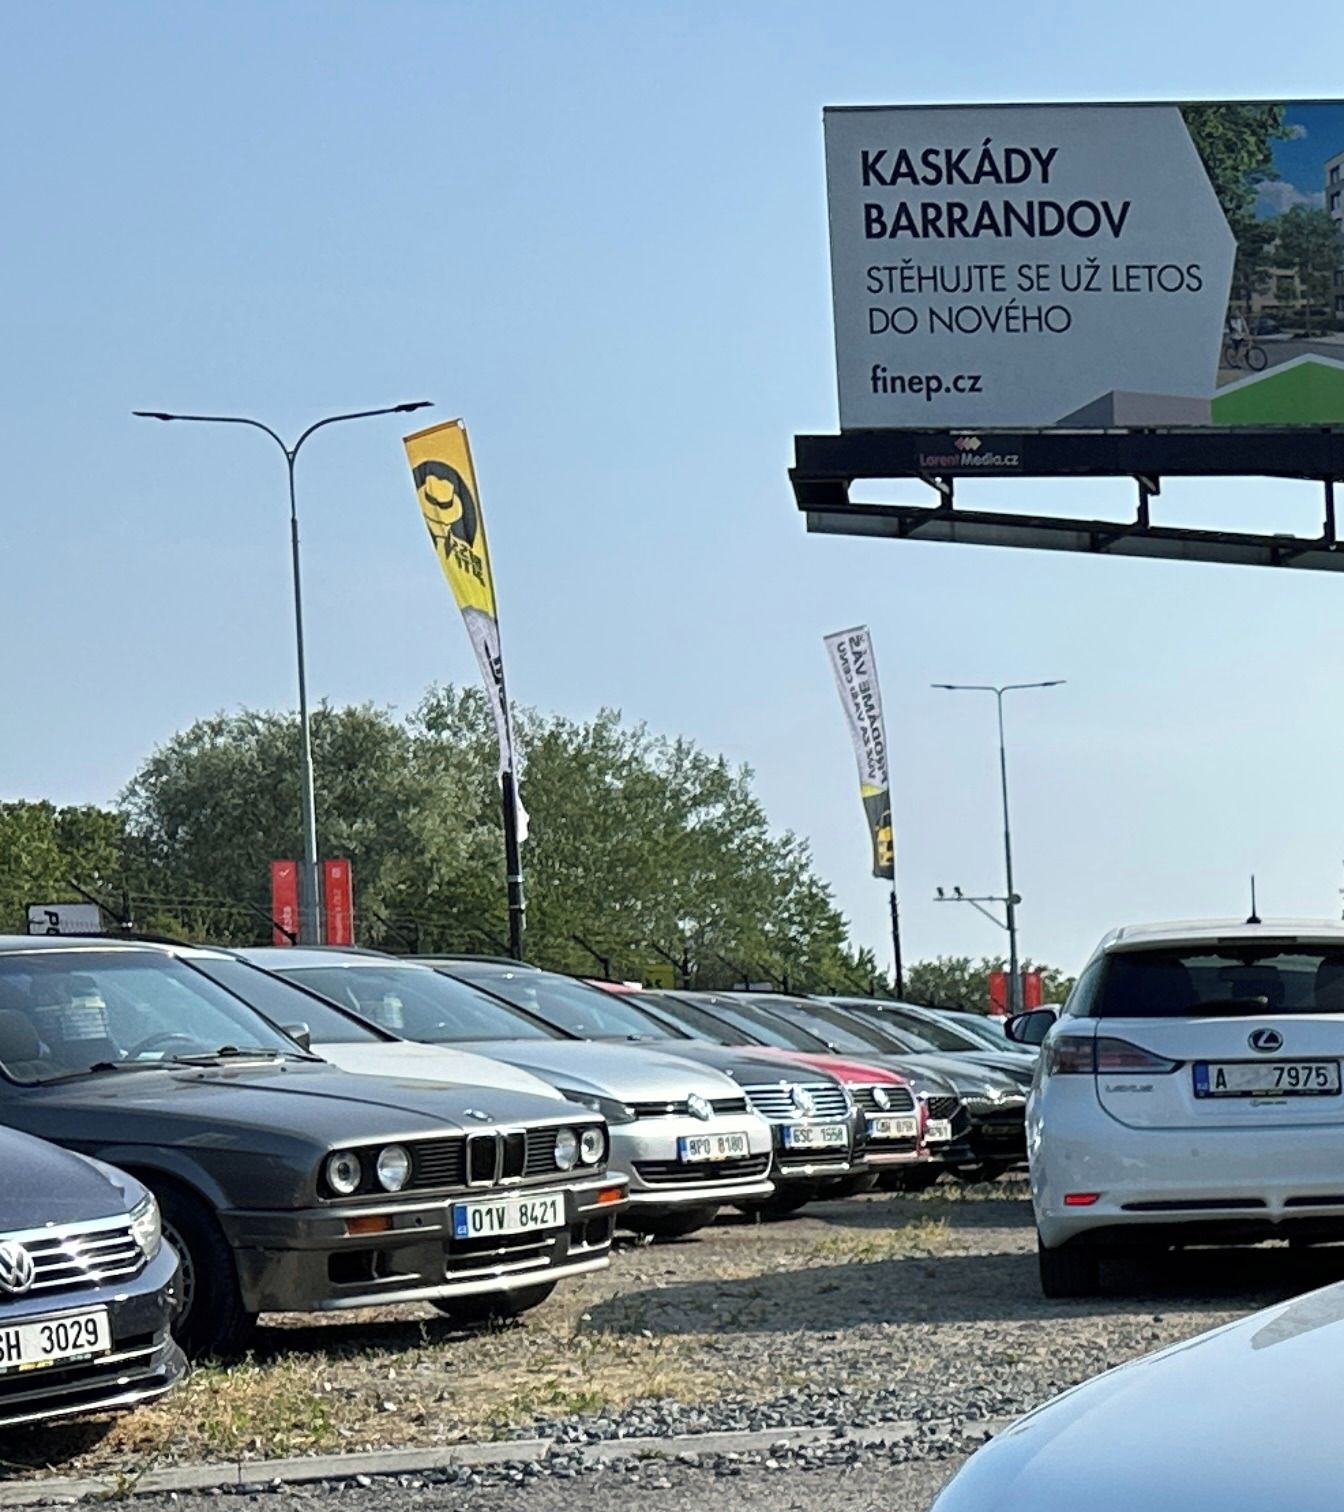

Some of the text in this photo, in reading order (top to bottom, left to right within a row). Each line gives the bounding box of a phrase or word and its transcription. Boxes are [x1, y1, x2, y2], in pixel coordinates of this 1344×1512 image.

[861, 137, 1058, 186] KASKÁDY
[864, 200, 1131, 239] BARRANDOV
[866, 257, 1202, 294] STĚHUJTE SE UŽ LETOS
[869, 298, 1072, 335] DO NOVÉHO
[870, 364, 982, 401] finep.cz
[1215, 1066, 1329, 1090] A 7975
[472, 1200, 557, 1232] 01V 8421
[40, 1318, 99, 1354] 3029
